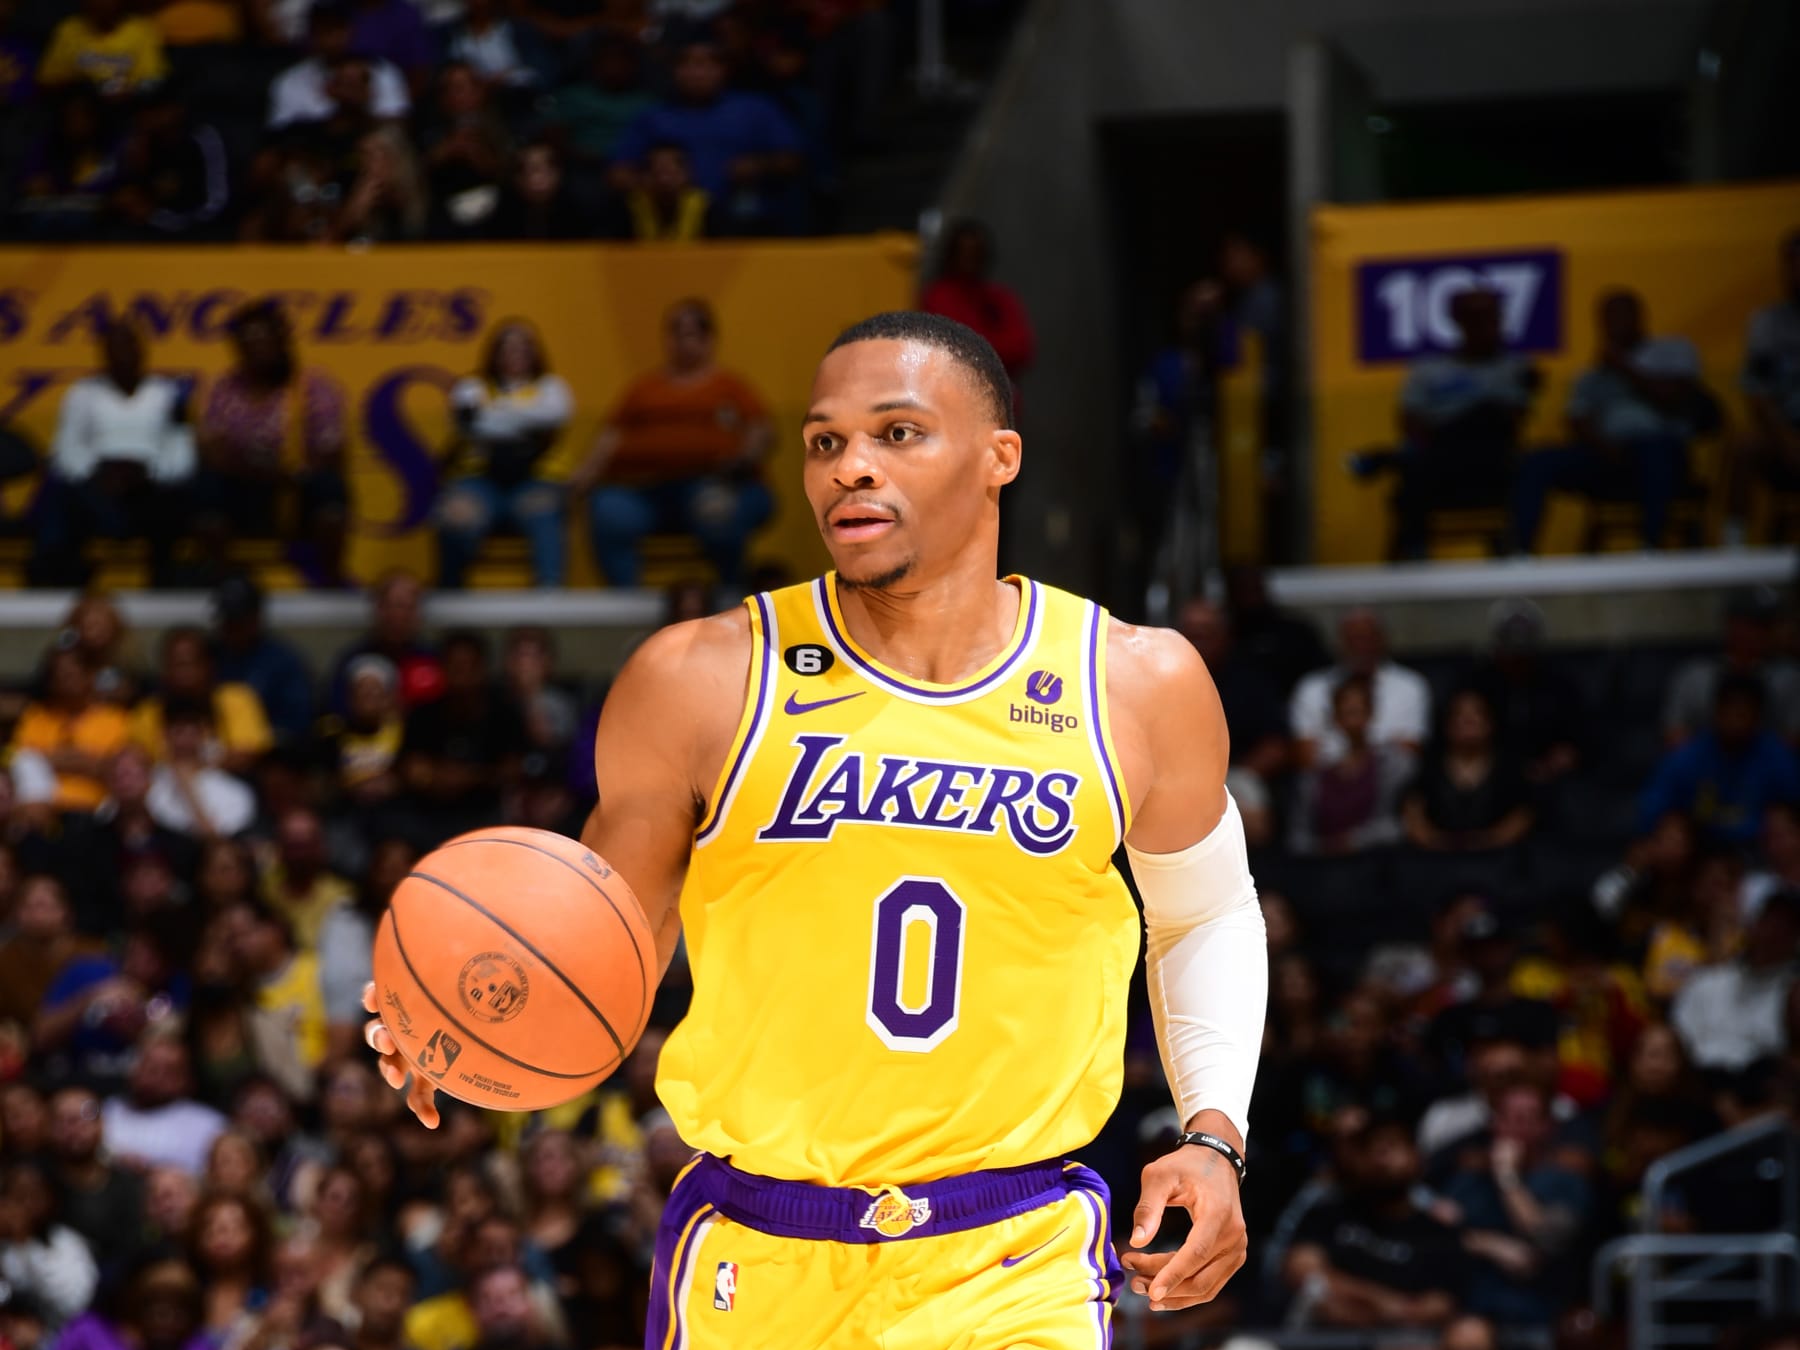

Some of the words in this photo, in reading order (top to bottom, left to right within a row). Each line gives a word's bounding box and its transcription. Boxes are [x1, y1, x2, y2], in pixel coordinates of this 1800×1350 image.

[50, 288, 486, 343] ANGLES
[796, 648, 822, 673] 6
[1009, 704, 1077, 732] bibigo
[756, 734, 1082, 856] LAKERS
[866, 875, 966, 1053] 0
